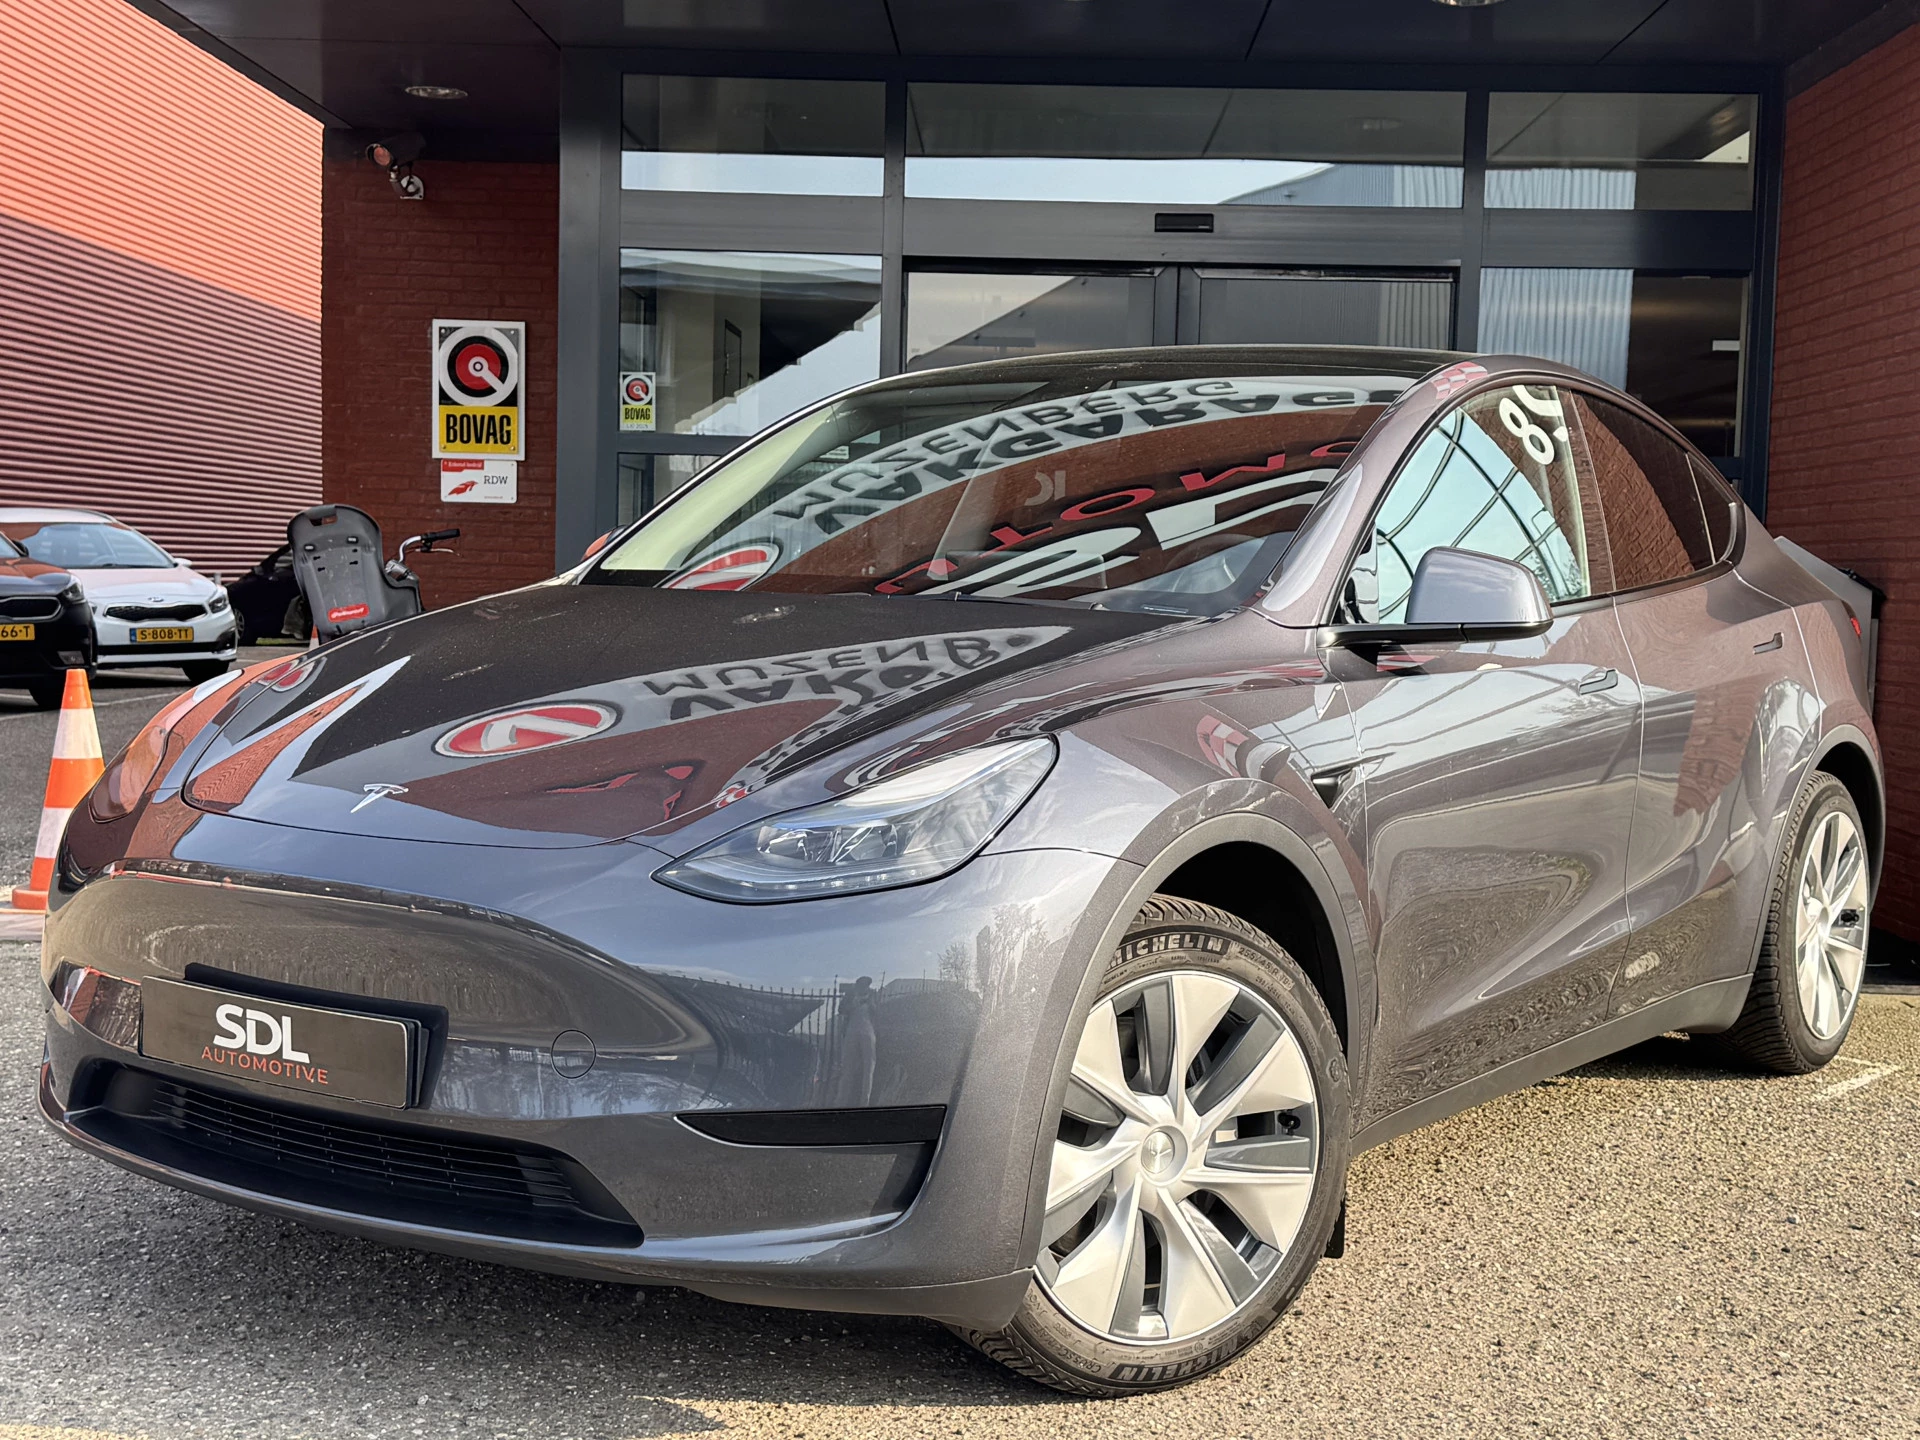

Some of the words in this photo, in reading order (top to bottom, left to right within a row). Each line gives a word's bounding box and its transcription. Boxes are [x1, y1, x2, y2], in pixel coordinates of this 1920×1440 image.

[445, 413, 512, 445] BOVAG
[624, 407, 651, 420] BOVAG
[483, 475, 508, 485] RDW
[140, 628, 189, 640] S-808-TT
[213, 1003, 310, 1064] SDL
[202, 1046, 328, 1085] AUTOMOTIVE
[1115, 1338, 1237, 1382] MICHELIN
